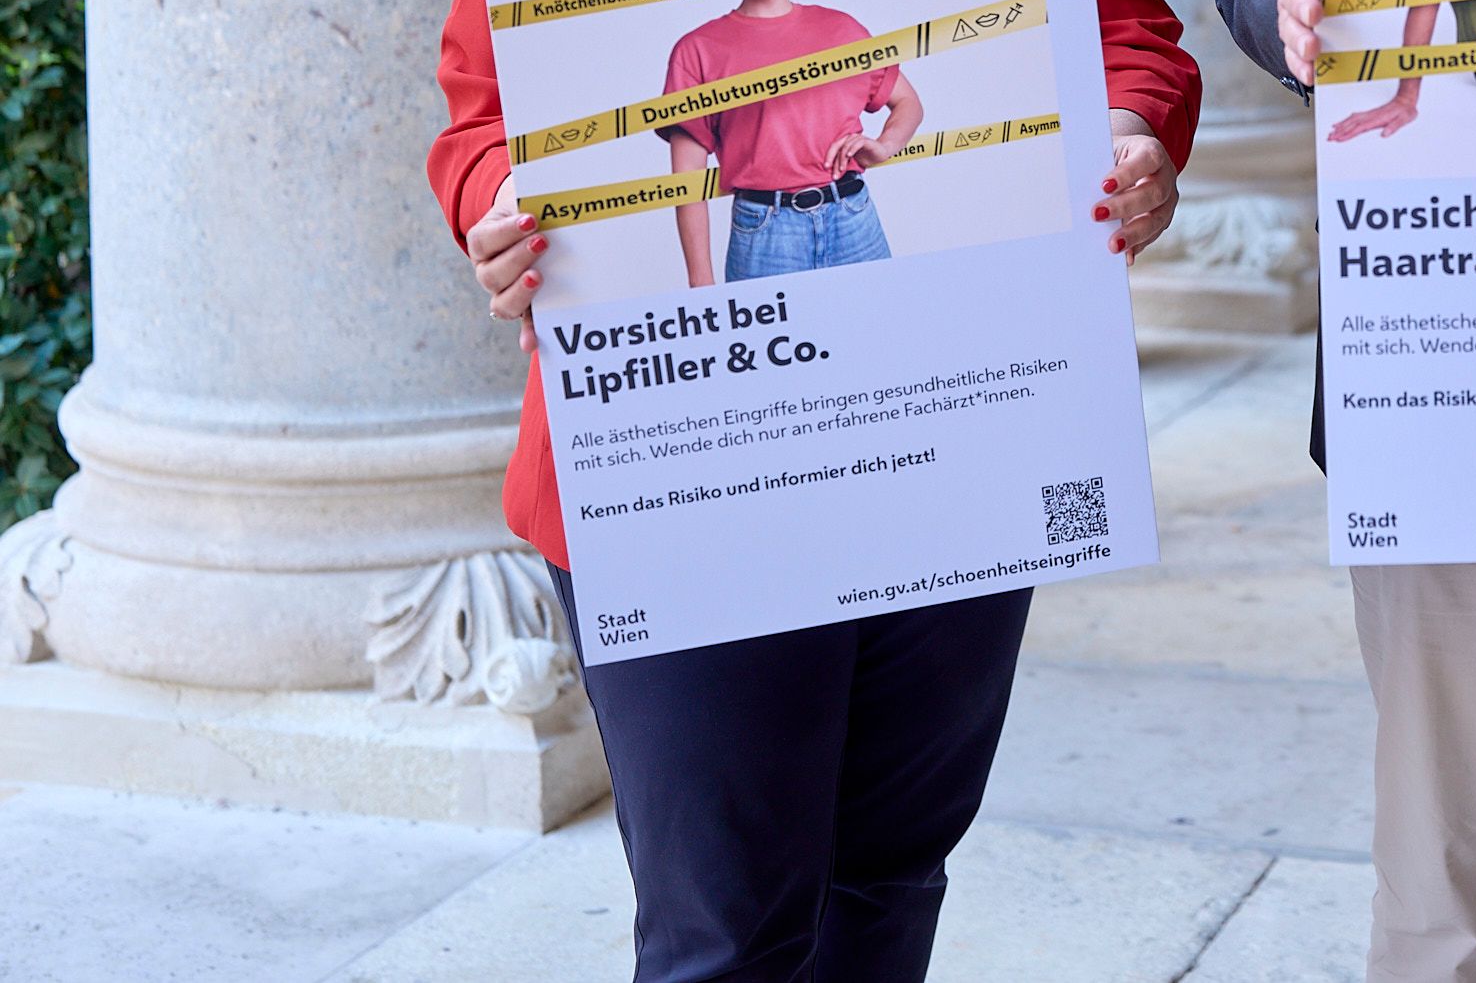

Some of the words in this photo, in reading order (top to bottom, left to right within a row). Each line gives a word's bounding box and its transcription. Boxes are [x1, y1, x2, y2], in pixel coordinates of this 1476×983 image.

[642, 45, 898, 124] Durchblutungsstörungen
[539, 185, 687, 226] Asymmetrien
[553, 306, 720, 355] Vorsicht
[728, 292, 787, 330] bei
[1341, 316, 1375, 331] Alle
[1342, 340, 1370, 355] mit
[1376, 338, 1414, 355] sich.
[561, 353, 716, 404] Lipfiller
[727, 342, 757, 373] &
[767, 336, 829, 366] Co.
[572, 432, 604, 449] Alle
[609, 416, 719, 443] ästhetischen
[724, 400, 797, 425] Eingriffe
[801, 392, 868, 412] bringen
[873, 367, 1005, 405] gesundheitliche
[1010, 359, 1068, 378] Risiken
[1344, 394, 1391, 408] Kenn
[1396, 391, 1428, 407] das
[575, 455, 602, 471] mit
[607, 448, 646, 466] sich.
[649, 437, 712, 458] Wende
[718, 429, 753, 448] dich
[759, 427, 787, 441] nur
[792, 424, 812, 436] an
[817, 409, 900, 432] erfahrene
[581, 504, 628, 520] Kenn
[633, 496, 664, 511] das
[668, 486, 722, 506] Risiko
[726, 477, 760, 496] und
[764, 466, 846, 490] informier
[851, 456, 887, 475] dich
[891, 448, 935, 473] jetzt!
[1348, 512, 1397, 528] Stadt
[1348, 532, 1398, 547] Wien
[837, 544, 1111, 605] wien.gv.at/schoenheitseingriffe
[598, 609, 646, 629] Stadt
[599, 629, 649, 646] Wien
